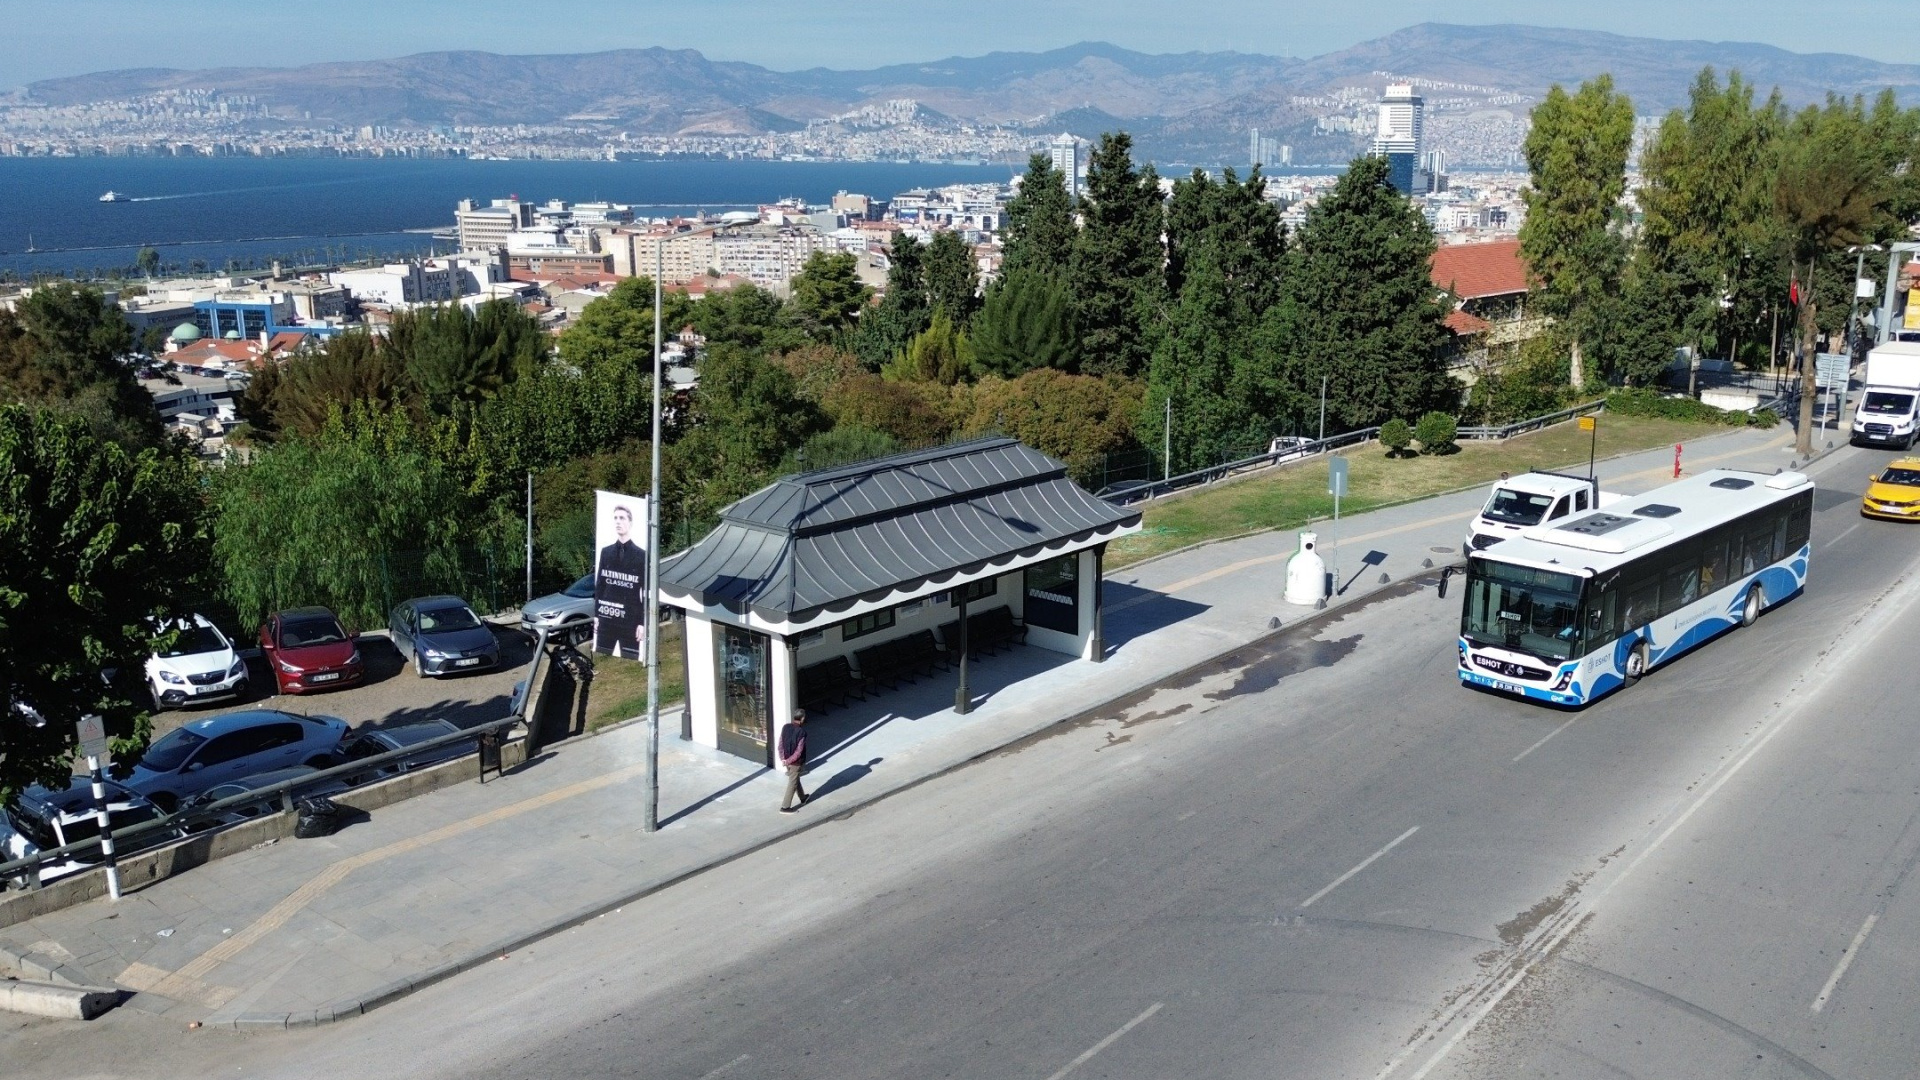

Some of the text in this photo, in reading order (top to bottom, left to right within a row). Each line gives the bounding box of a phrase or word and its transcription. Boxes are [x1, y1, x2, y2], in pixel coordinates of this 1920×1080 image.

[605, 578, 633, 589] CLASSICS
[598, 605, 620, 617] 4999
[1476, 657, 1502, 669] ESHOT
